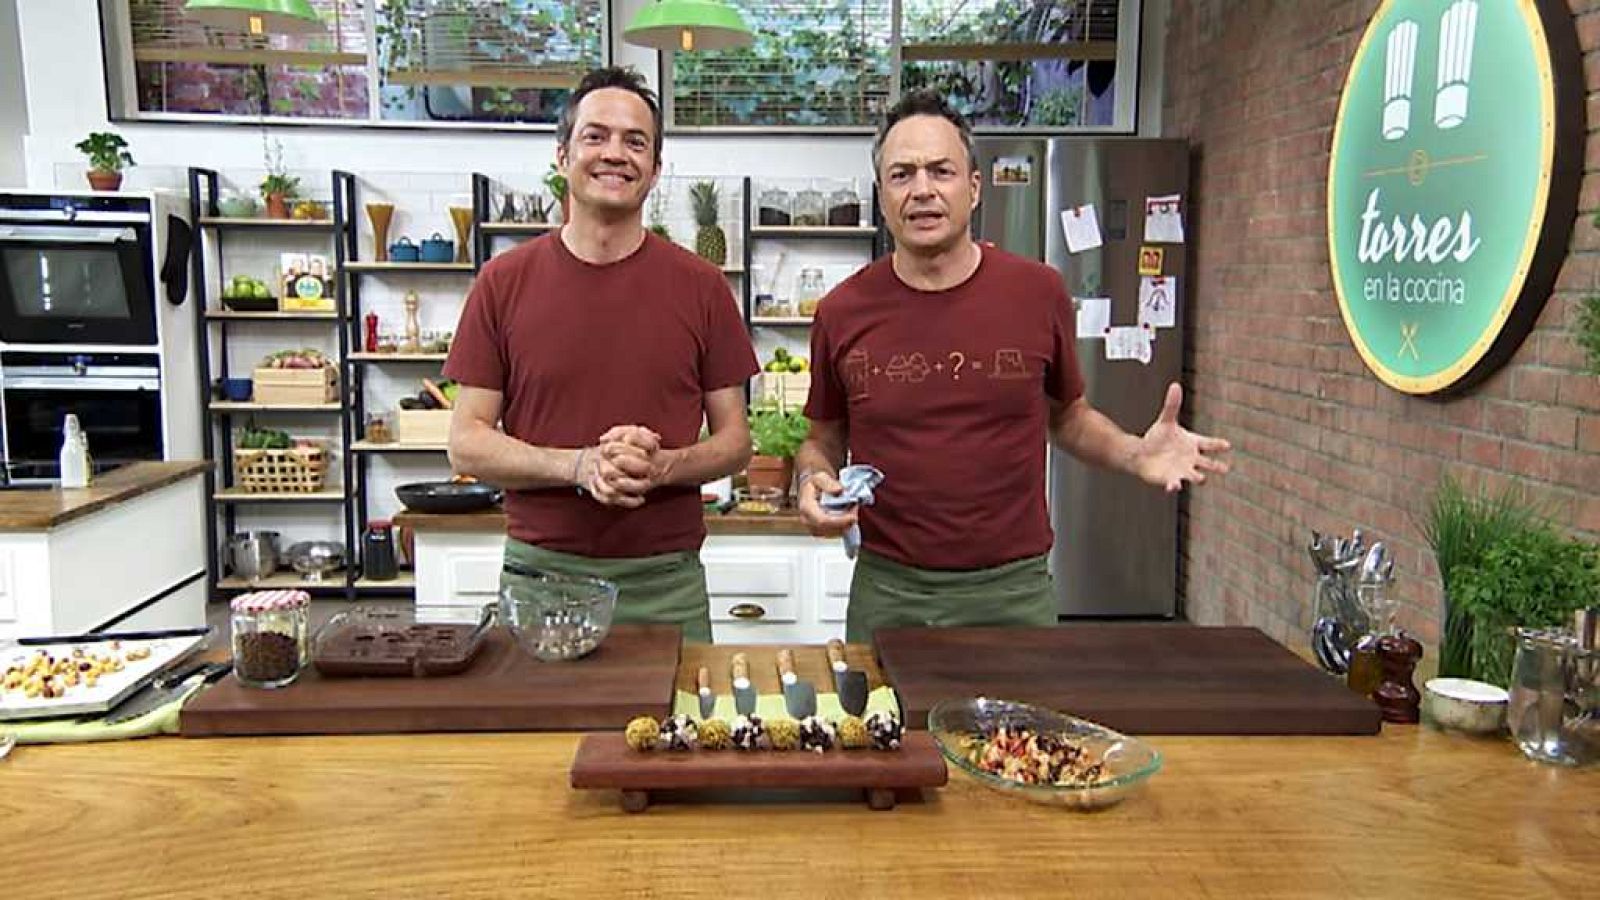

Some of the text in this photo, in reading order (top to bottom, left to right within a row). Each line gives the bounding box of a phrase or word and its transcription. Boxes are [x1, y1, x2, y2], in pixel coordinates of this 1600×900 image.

[1358, 187, 1481, 263] torres
[1363, 272, 1465, 304] en la cocina
